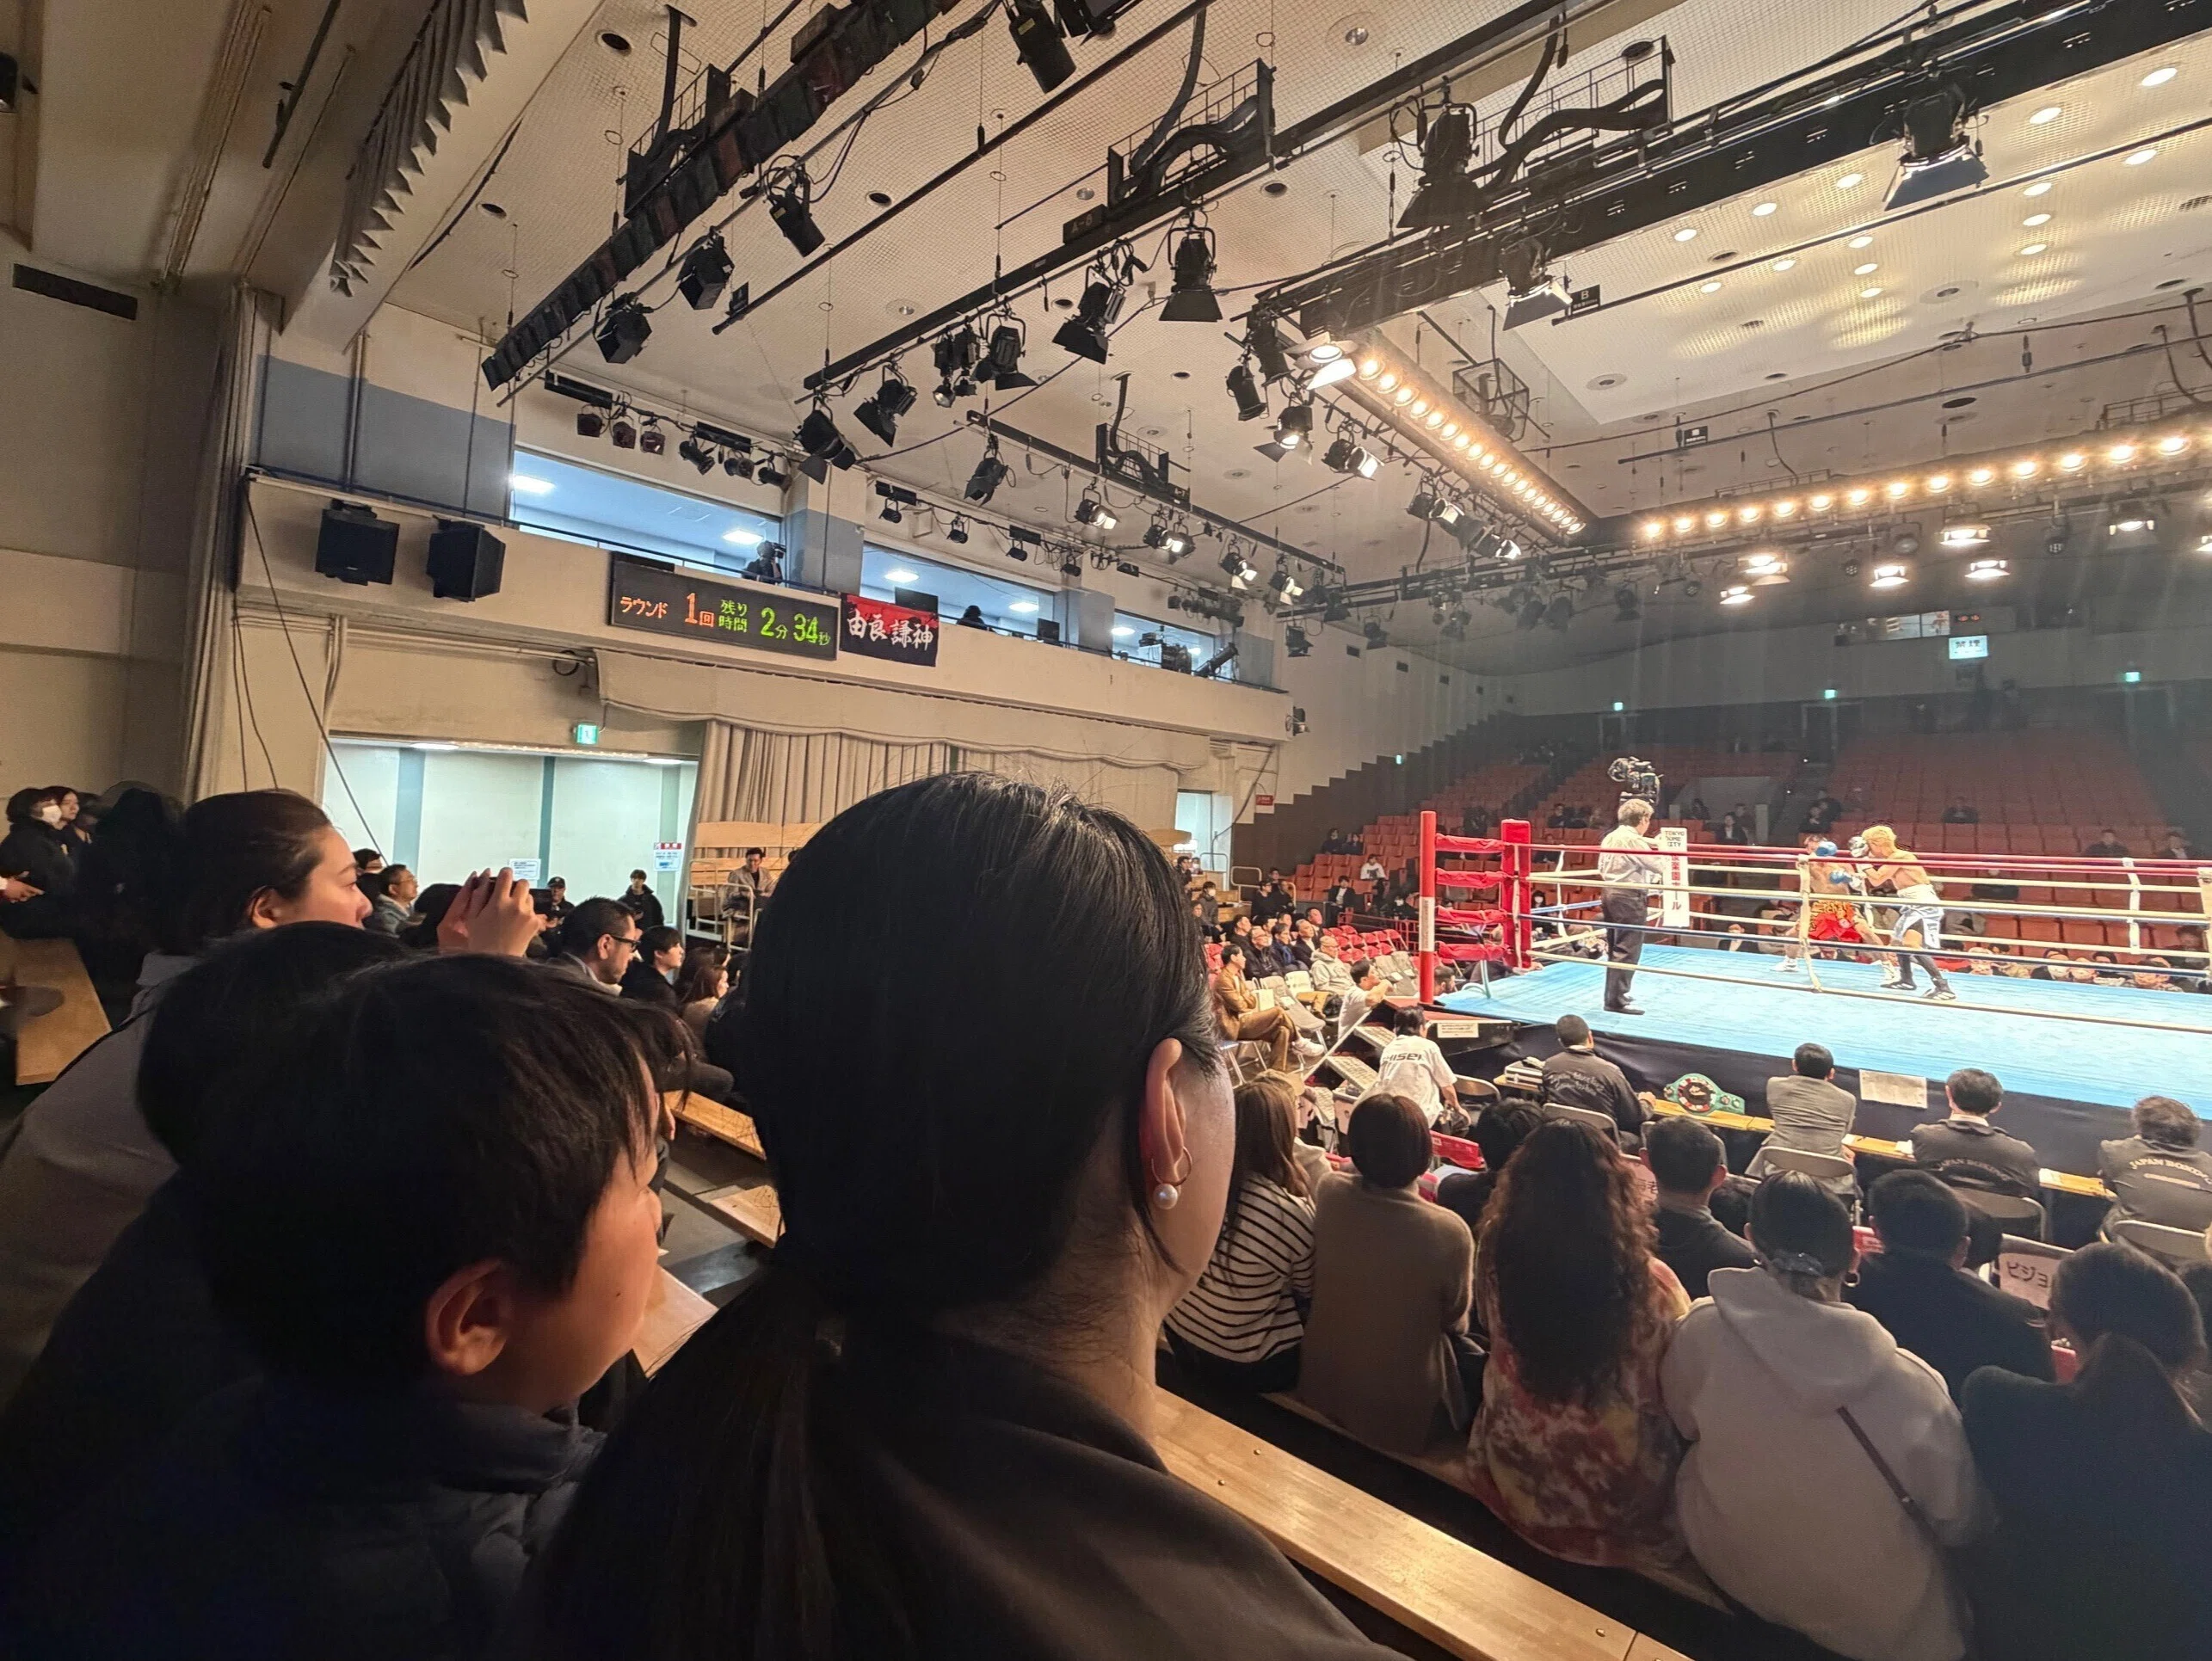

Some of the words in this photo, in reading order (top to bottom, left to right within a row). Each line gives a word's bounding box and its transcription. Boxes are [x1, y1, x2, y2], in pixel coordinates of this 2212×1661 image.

[1580, 290, 1590, 300] B
[620, 596, 669, 618] ラウンド
[720, 599, 748, 617] 残り
[718, 615, 748, 633] 時間
[847, 608, 934, 651] 由良謙神
[2129, 1158, 2164, 1170] JAPAN
